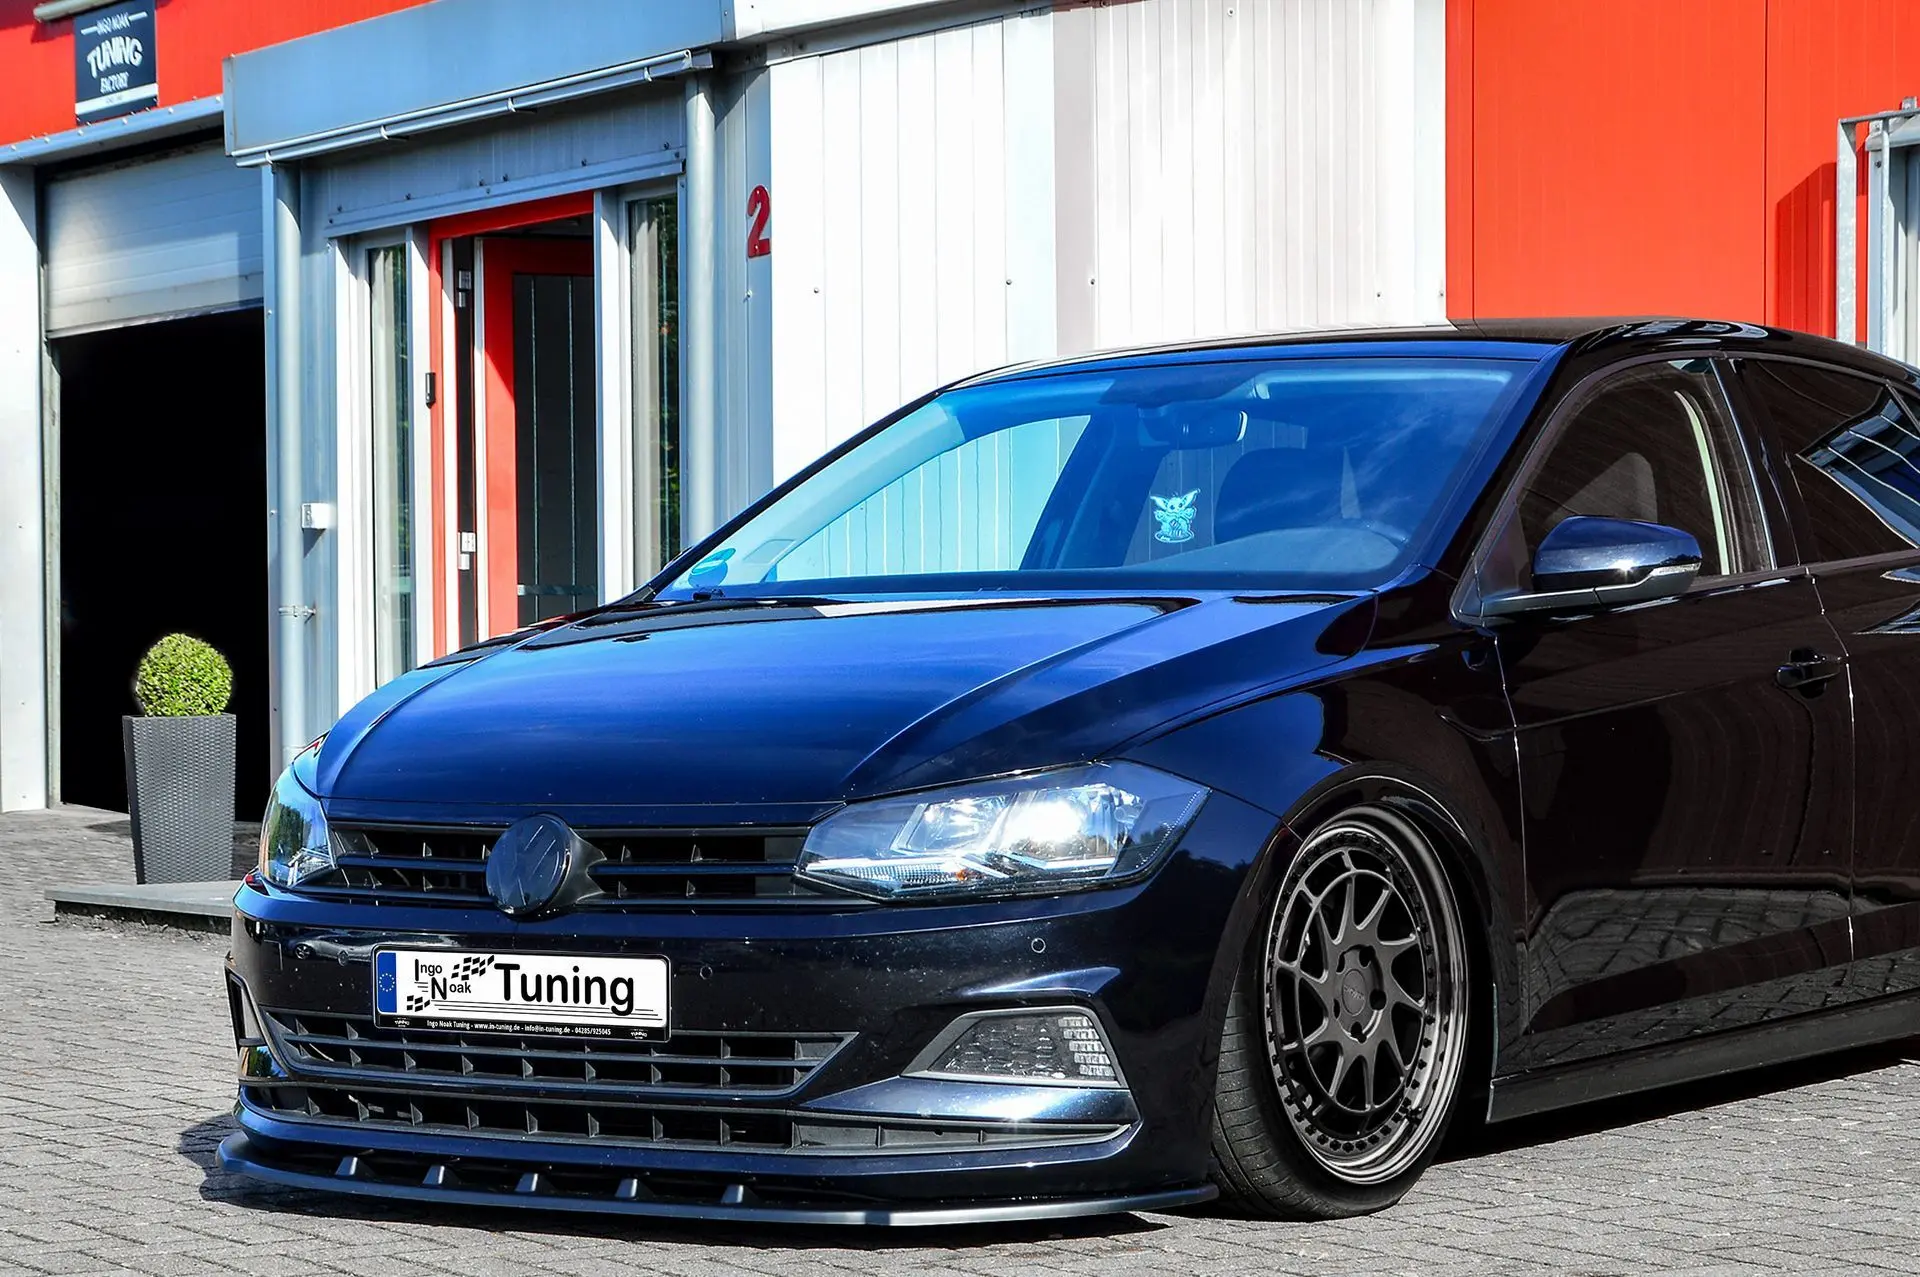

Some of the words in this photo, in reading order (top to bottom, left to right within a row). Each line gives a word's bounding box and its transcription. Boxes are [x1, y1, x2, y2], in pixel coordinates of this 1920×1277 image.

[87, 36, 143, 79] TUNING
[747, 184, 771, 258] 2
[415, 958, 443, 982] Ingo
[431, 977, 471, 1000] Noak
[494, 963, 634, 1016] Tuning
[426, 1020, 438, 1028] Ingo
[453, 1021, 470, 1030] Tuning
